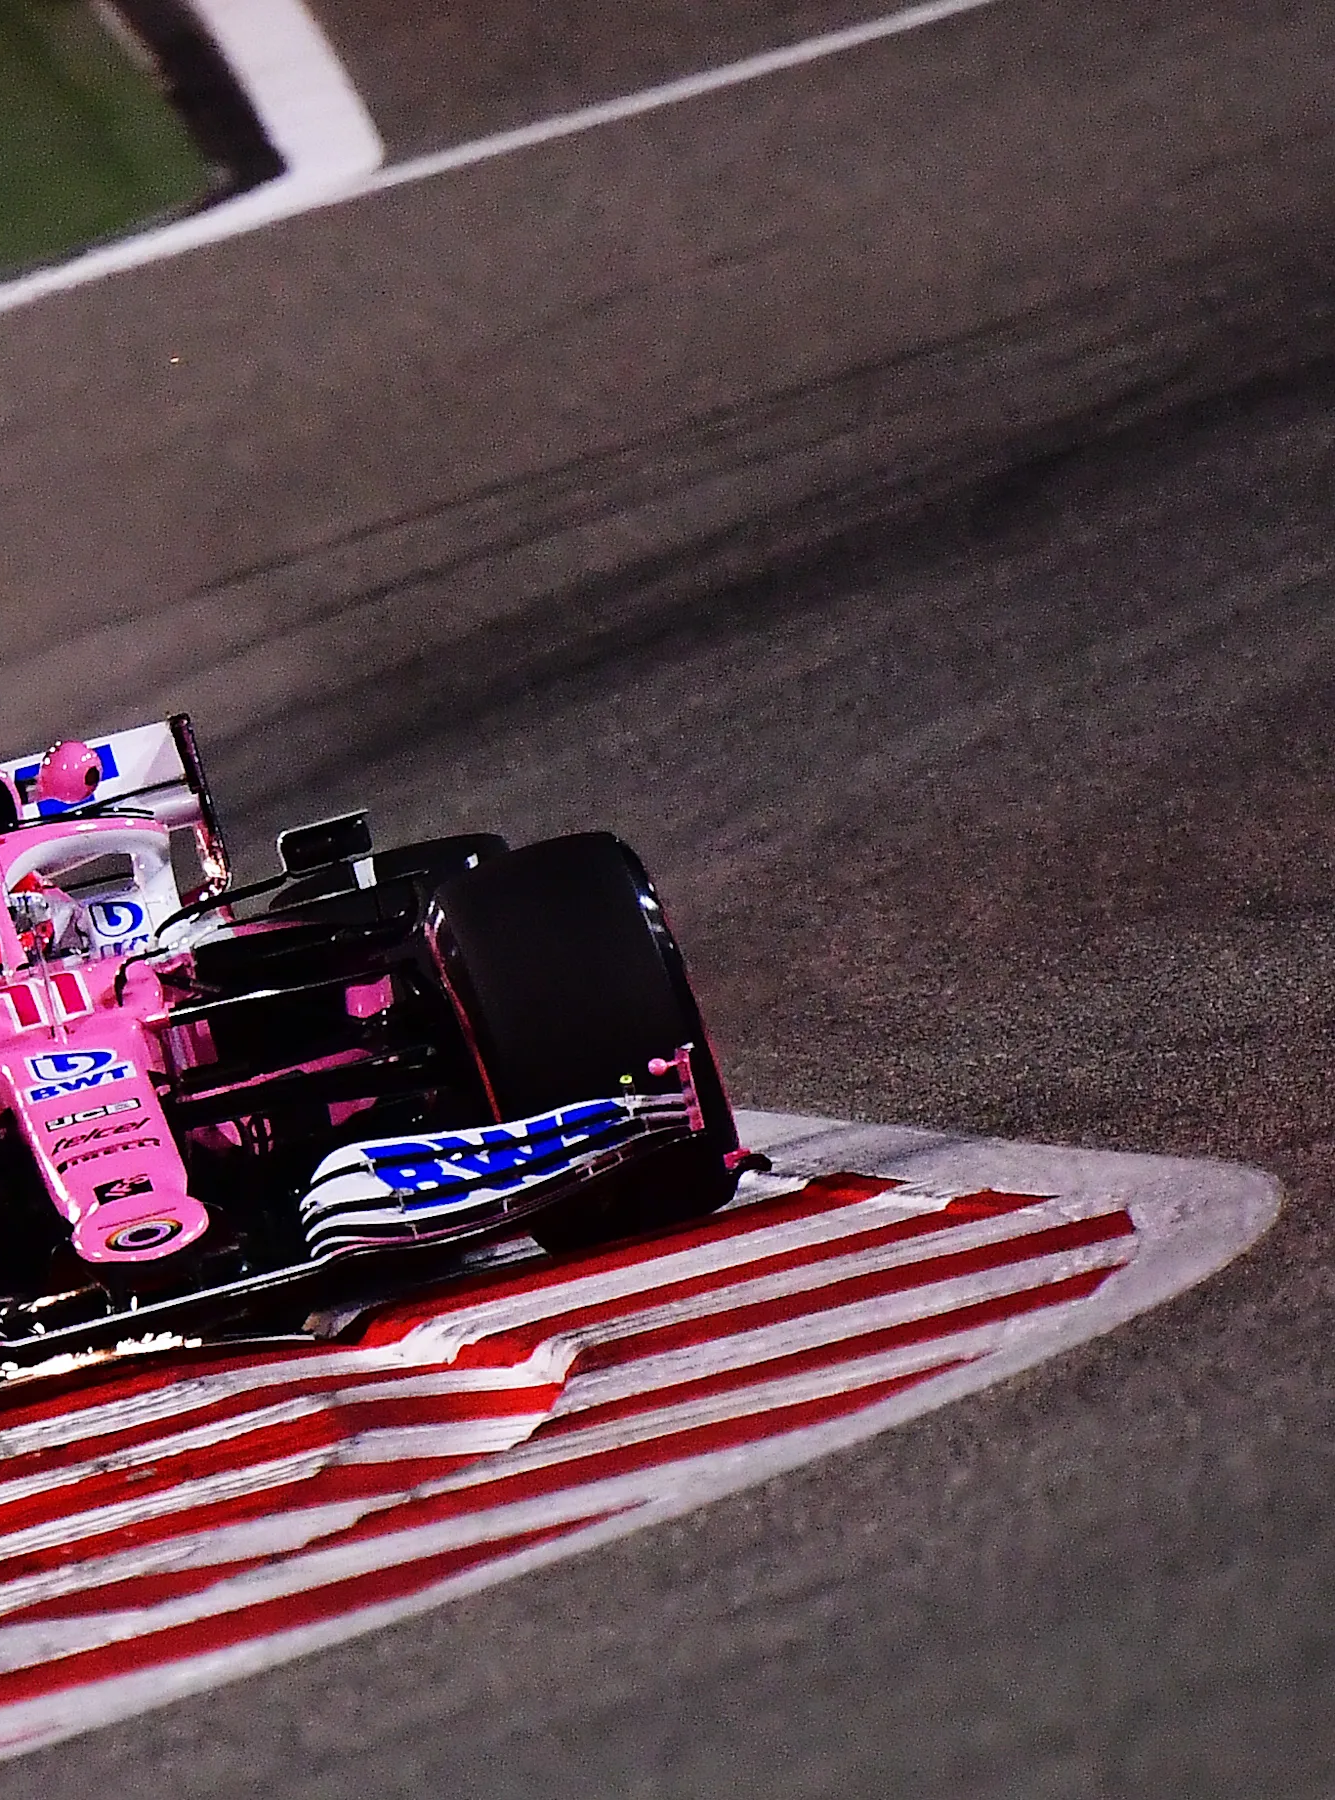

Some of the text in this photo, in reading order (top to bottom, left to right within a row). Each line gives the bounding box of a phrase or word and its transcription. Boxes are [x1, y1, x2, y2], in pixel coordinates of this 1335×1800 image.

[29, 1065, 129, 1102] BWT
[46, 1098, 141, 1132] JCB
[360, 1099, 630, 1212] BWT
